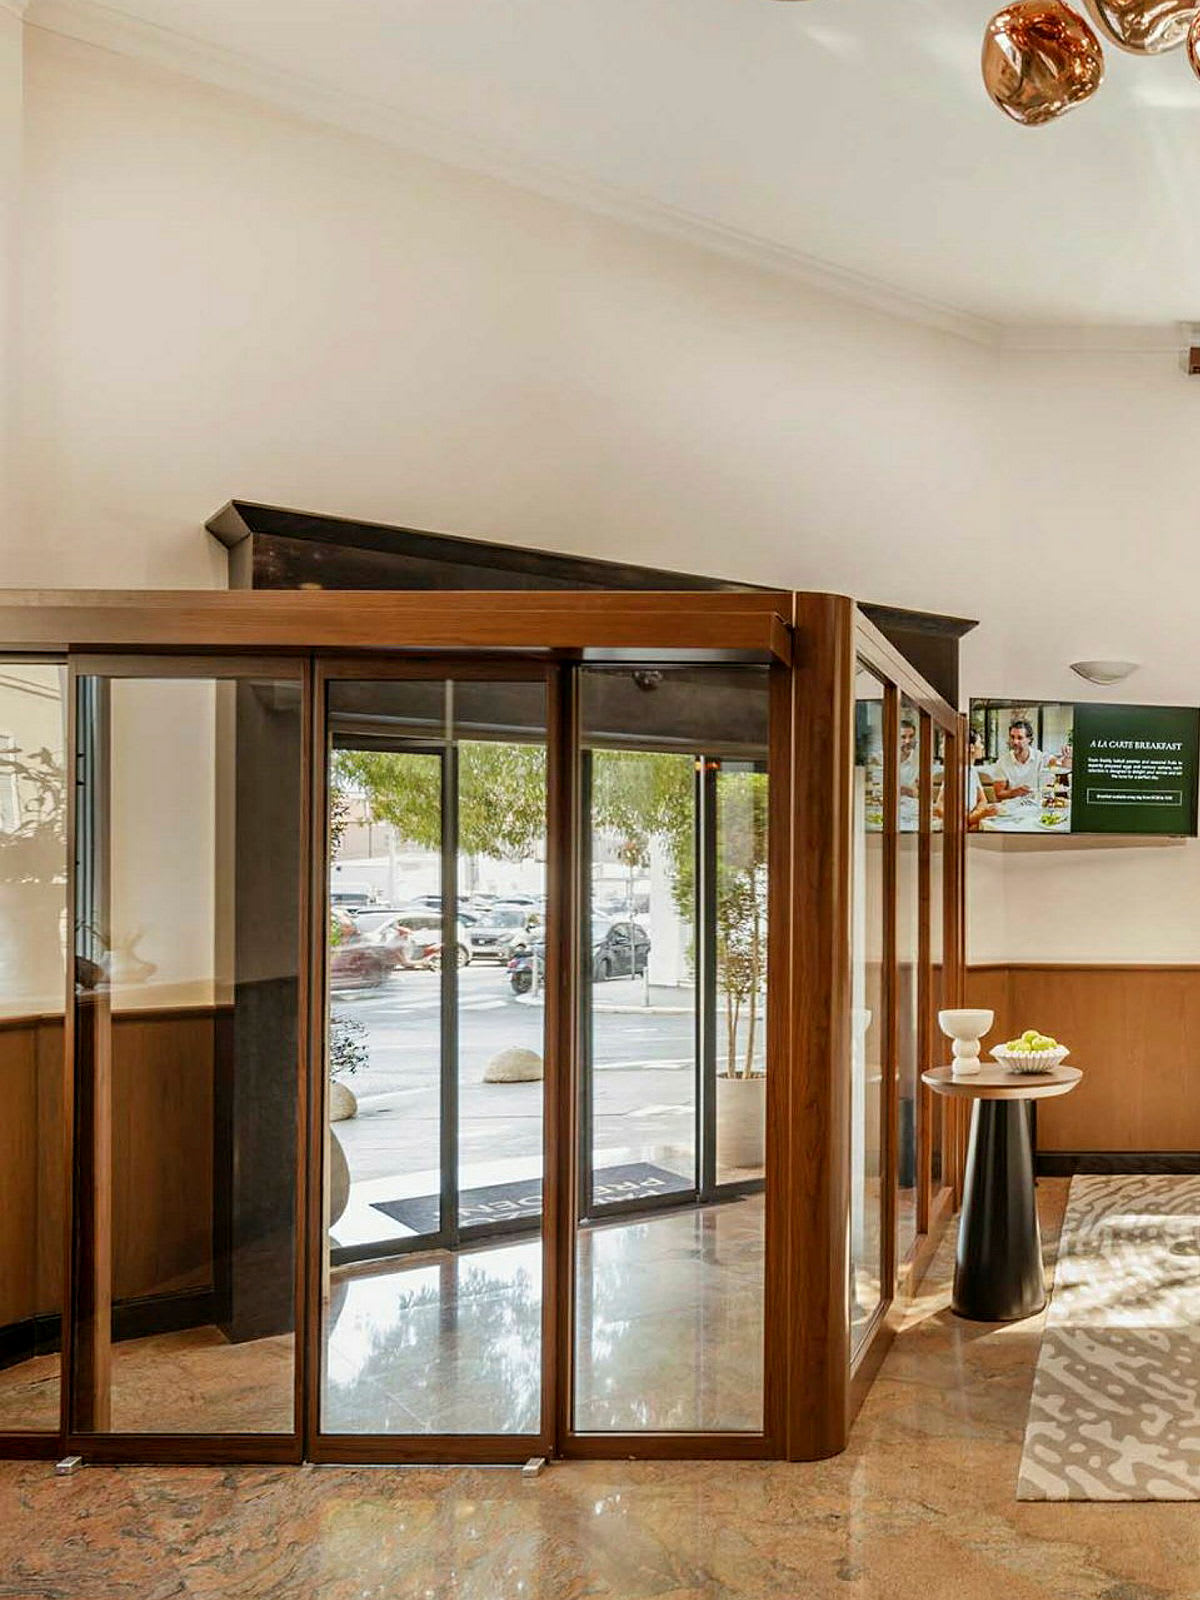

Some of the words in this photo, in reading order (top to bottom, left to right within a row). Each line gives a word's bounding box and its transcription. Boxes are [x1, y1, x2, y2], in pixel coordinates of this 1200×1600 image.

[1090, 740, 1096, 748] A
[1097, 740, 1108, 748] LA
[1108, 740, 1134, 749] CARTE
[1134, 741, 1183, 750] BREAKFAST
